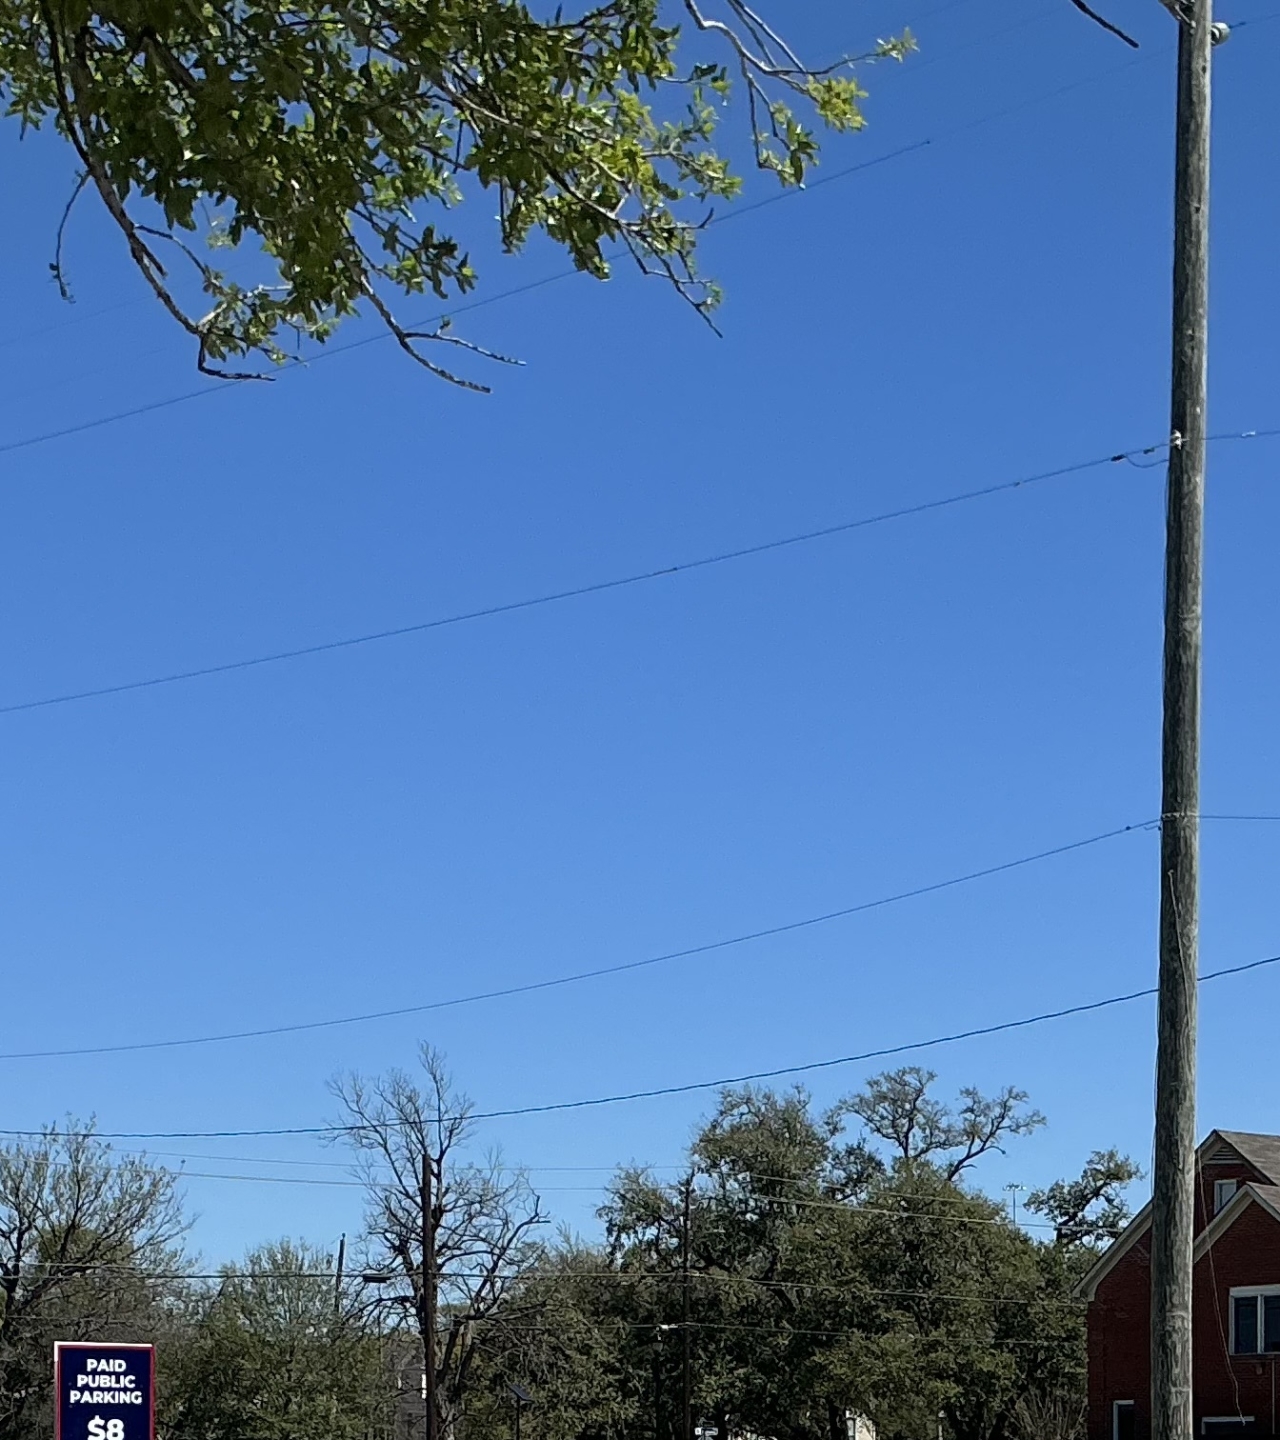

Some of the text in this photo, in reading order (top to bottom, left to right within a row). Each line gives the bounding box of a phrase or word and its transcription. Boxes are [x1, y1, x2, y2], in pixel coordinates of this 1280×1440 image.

[86, 1358, 127, 1372] PAID
[76, 1374, 136, 1389] PUBLIC
[69, 1389, 143, 1405] PARKING
